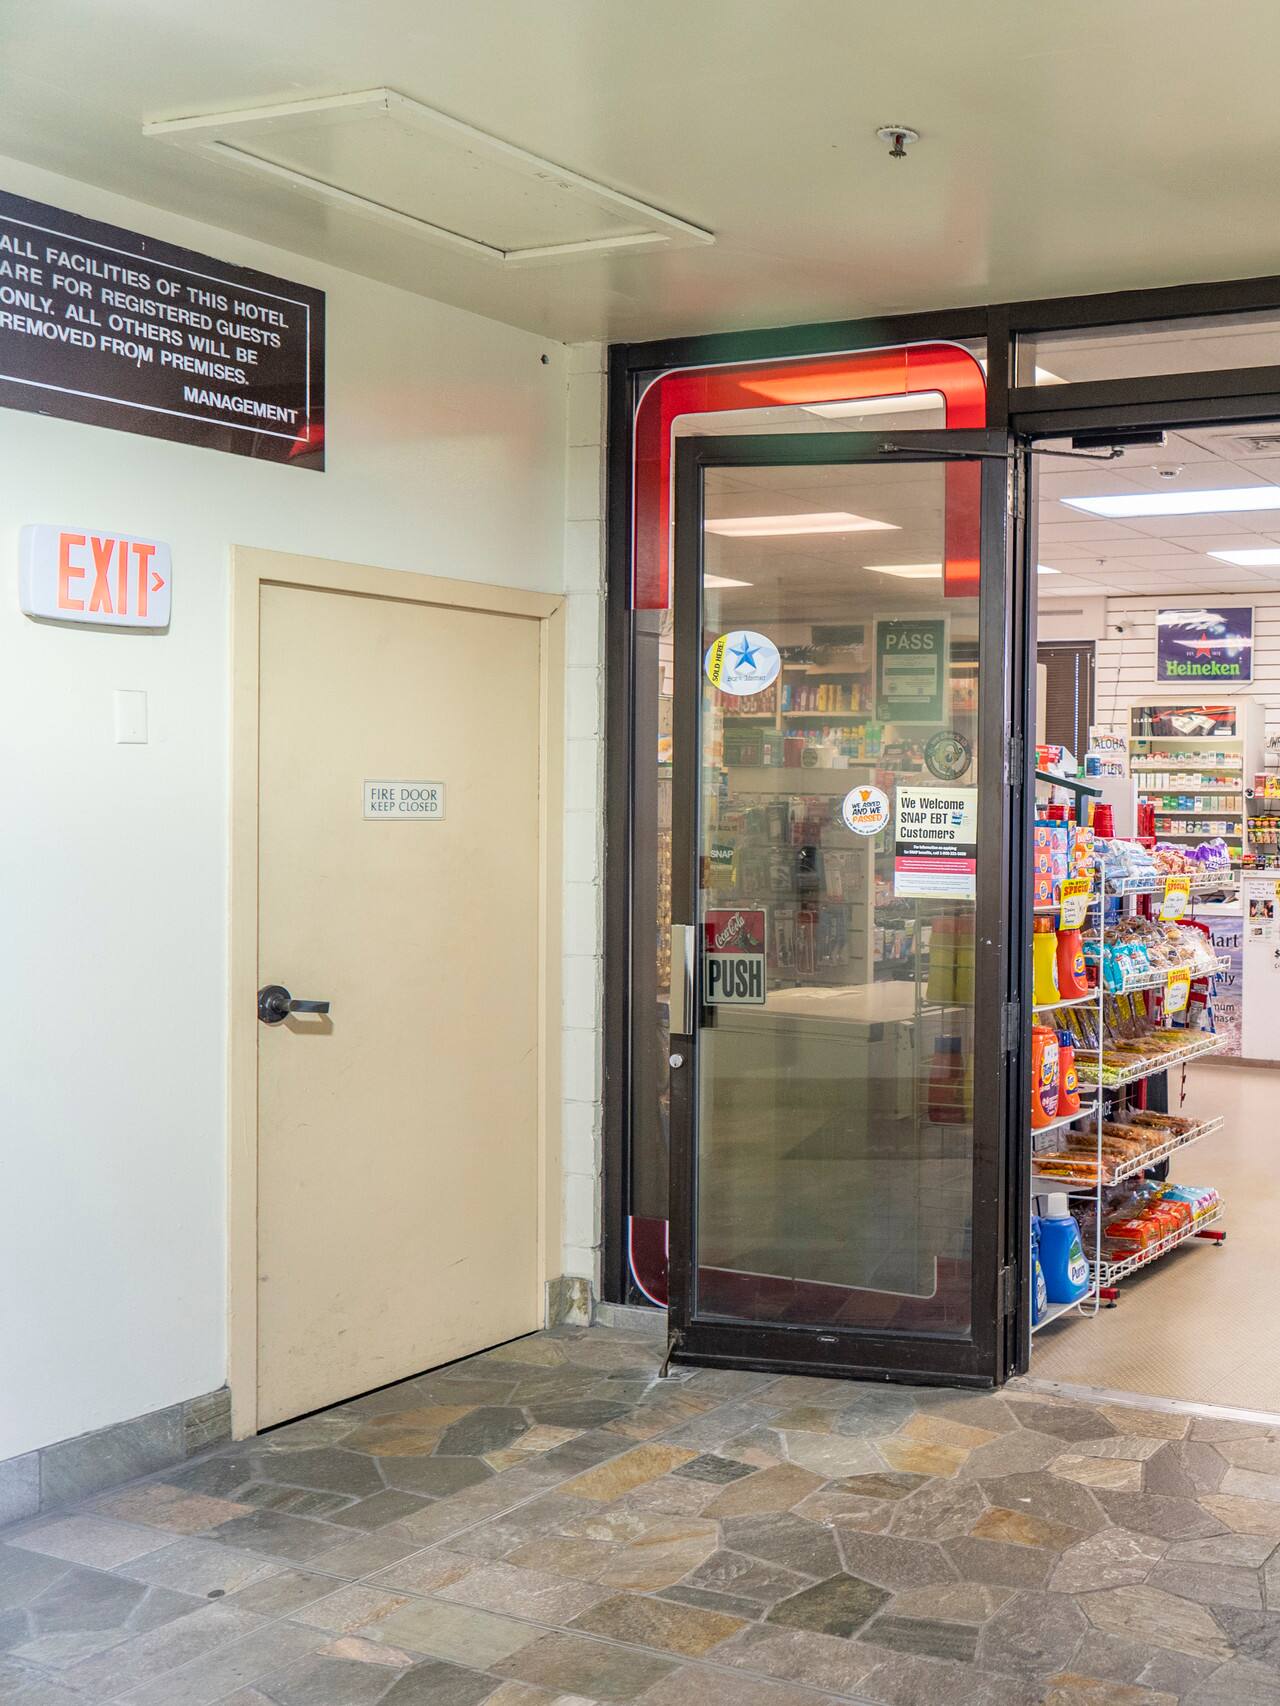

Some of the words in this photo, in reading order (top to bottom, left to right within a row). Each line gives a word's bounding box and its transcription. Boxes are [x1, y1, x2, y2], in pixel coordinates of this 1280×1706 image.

[0, 235, 38, 260] ALL
[46, 247, 150, 290] FACILITIES
[156, 278, 181, 297] OF
[187, 287, 228, 311] THIS
[234, 301, 289, 328] HOTEL
[0, 261, 42, 286] ARE
[53, 274, 92, 299] FOR
[101, 288, 212, 331] REGISTERED
[216, 320, 281, 348] GUESTS
[0, 287, 55, 315] ONLY.
[65, 304, 101, 327] ALL
[108, 314, 183, 346] OTHERS
[188, 335, 230, 359] WILL
[236, 347, 258, 365] BE
[0, 311, 96, 349] REMOVED
[100, 337, 154, 363] FROM
[160, 350, 250, 385] PREMISES.
[183, 386, 298, 424] MANAGEMENT
[58, 532, 155, 617] EXIT
[886, 633, 934, 650] PASS
[715, 640, 725, 662] HERE!
[712, 663, 721, 682] SOLD
[1166, 660, 1240, 676] Heineken
[371, 788, 396, 800] FIRE
[400, 788, 437, 801] DOOR
[901, 797, 916, 809] We
[920, 797, 965, 810] Welcome
[370, 802, 396, 811] KEEP
[398, 801, 438, 812] CLOSED
[852, 814, 882, 823] PASSED
[900, 812, 927, 824] SNAP
[930, 813, 948, 824] EBT
[900, 826, 955, 839] Customers
[711, 850, 733, 858] SNAP
[709, 959, 762, 998] PUSH
